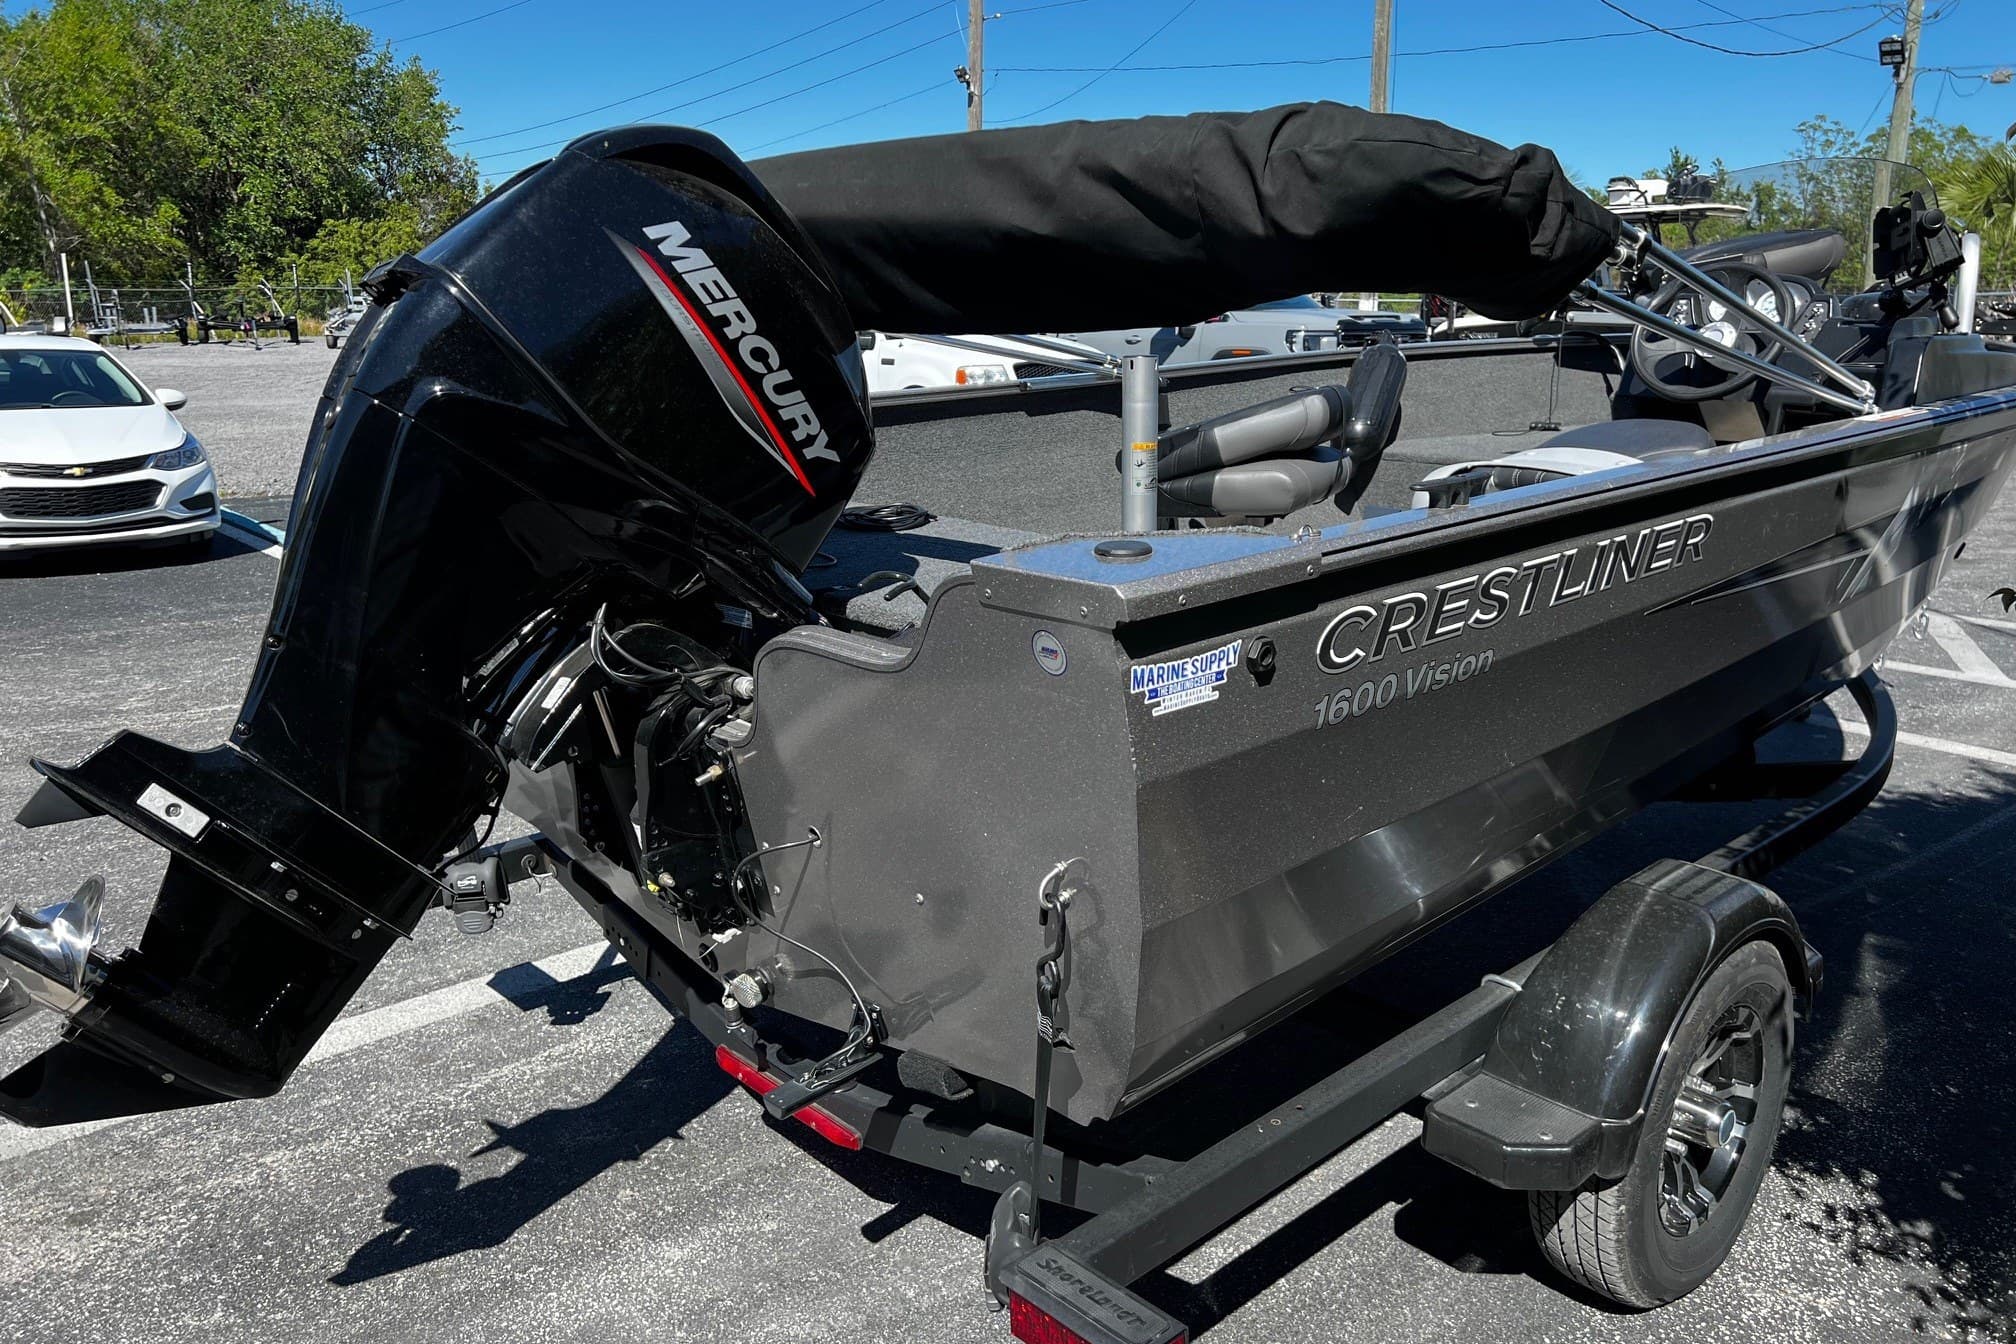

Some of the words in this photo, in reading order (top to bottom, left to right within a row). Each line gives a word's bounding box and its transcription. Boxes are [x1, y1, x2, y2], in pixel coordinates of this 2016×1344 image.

[642, 220, 840, 463] MERCURY
[1316, 513, 1714, 674] CRESTLINER
[1132, 660, 1189, 691] MARINE
[1191, 644, 1240, 675] SUPPLY
[1157, 685, 1169, 697] THE
[1313, 672, 1398, 730] 1600
[1405, 649, 1495, 699] Vision
